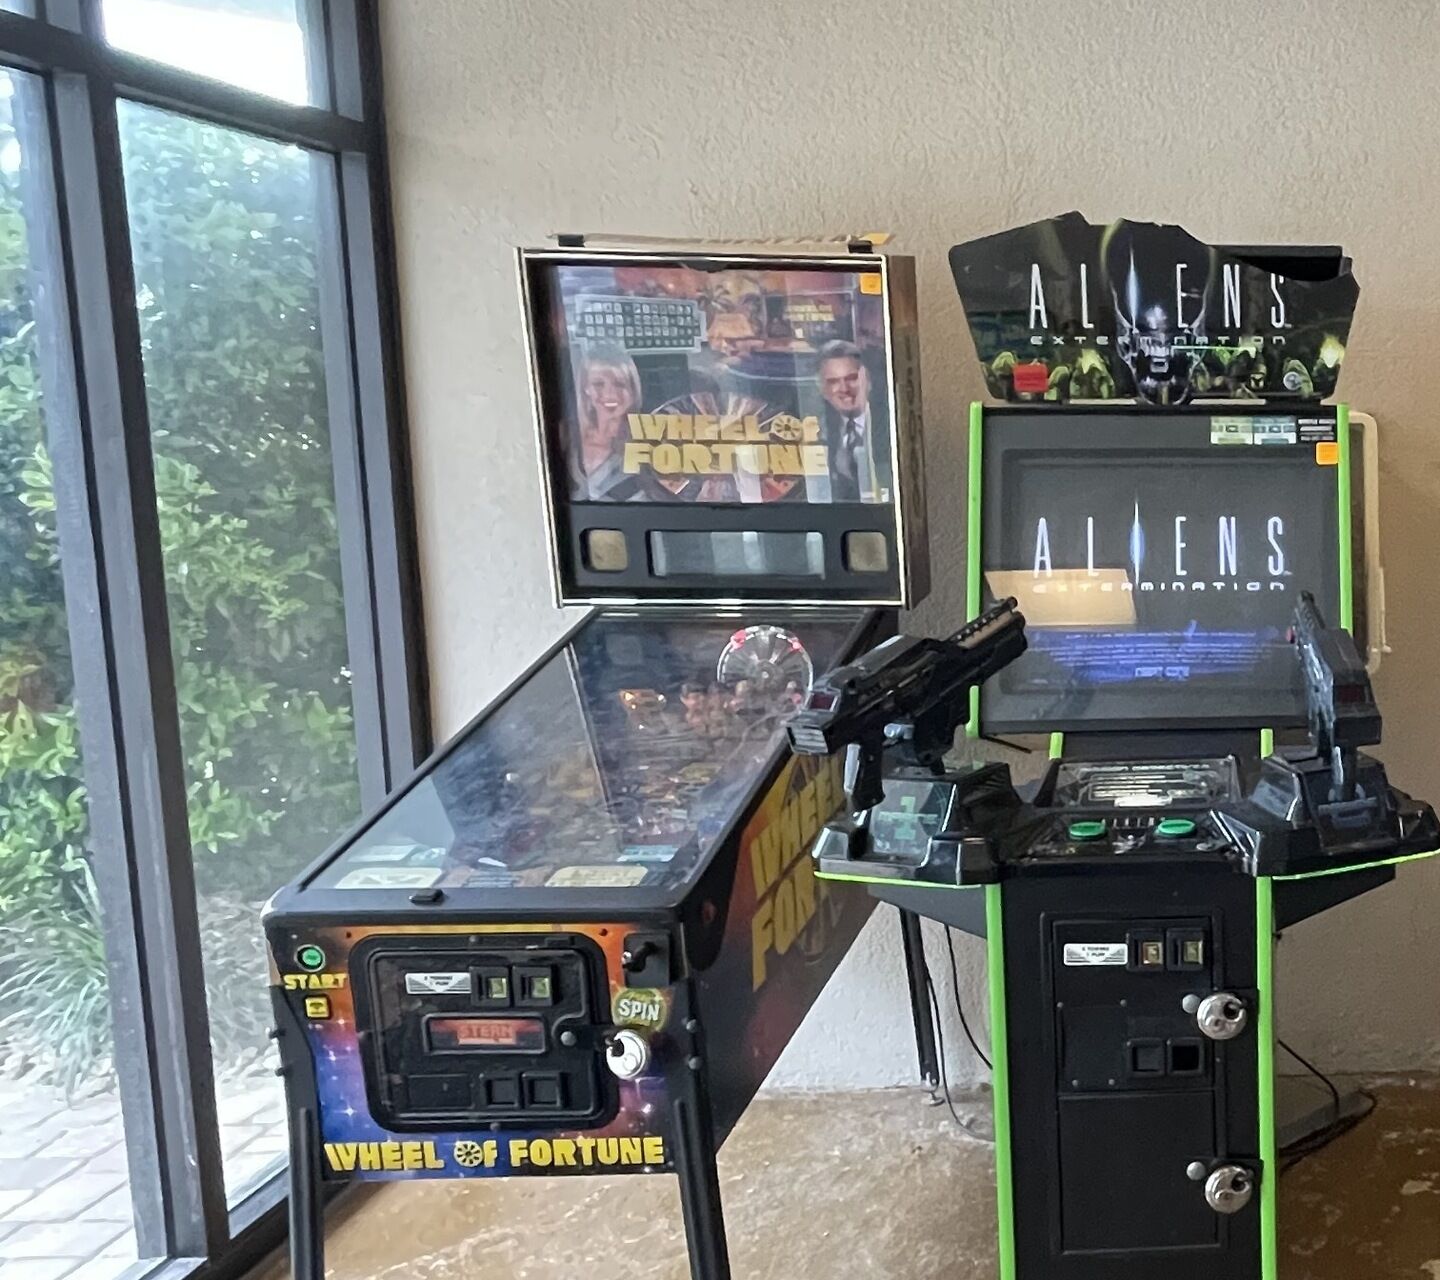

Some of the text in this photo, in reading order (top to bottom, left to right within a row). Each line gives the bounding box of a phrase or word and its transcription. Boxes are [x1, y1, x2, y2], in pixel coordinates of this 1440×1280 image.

[1028, 252, 1288, 331] ALIENS
[627, 413, 770, 442] WHEEL
[623, 442, 830, 476] FORTUNE
[1032, 506, 1287, 578] ALIENS
[1031, 580, 1286, 593] EXTERMINATION
[284, 973, 348, 991] START
[617, 998, 660, 1022] SPIN
[458, 1024, 514, 1039] STERN
[323, 1140, 445, 1171] WHEEL
[508, 1136, 665, 1167] FORTUNE
